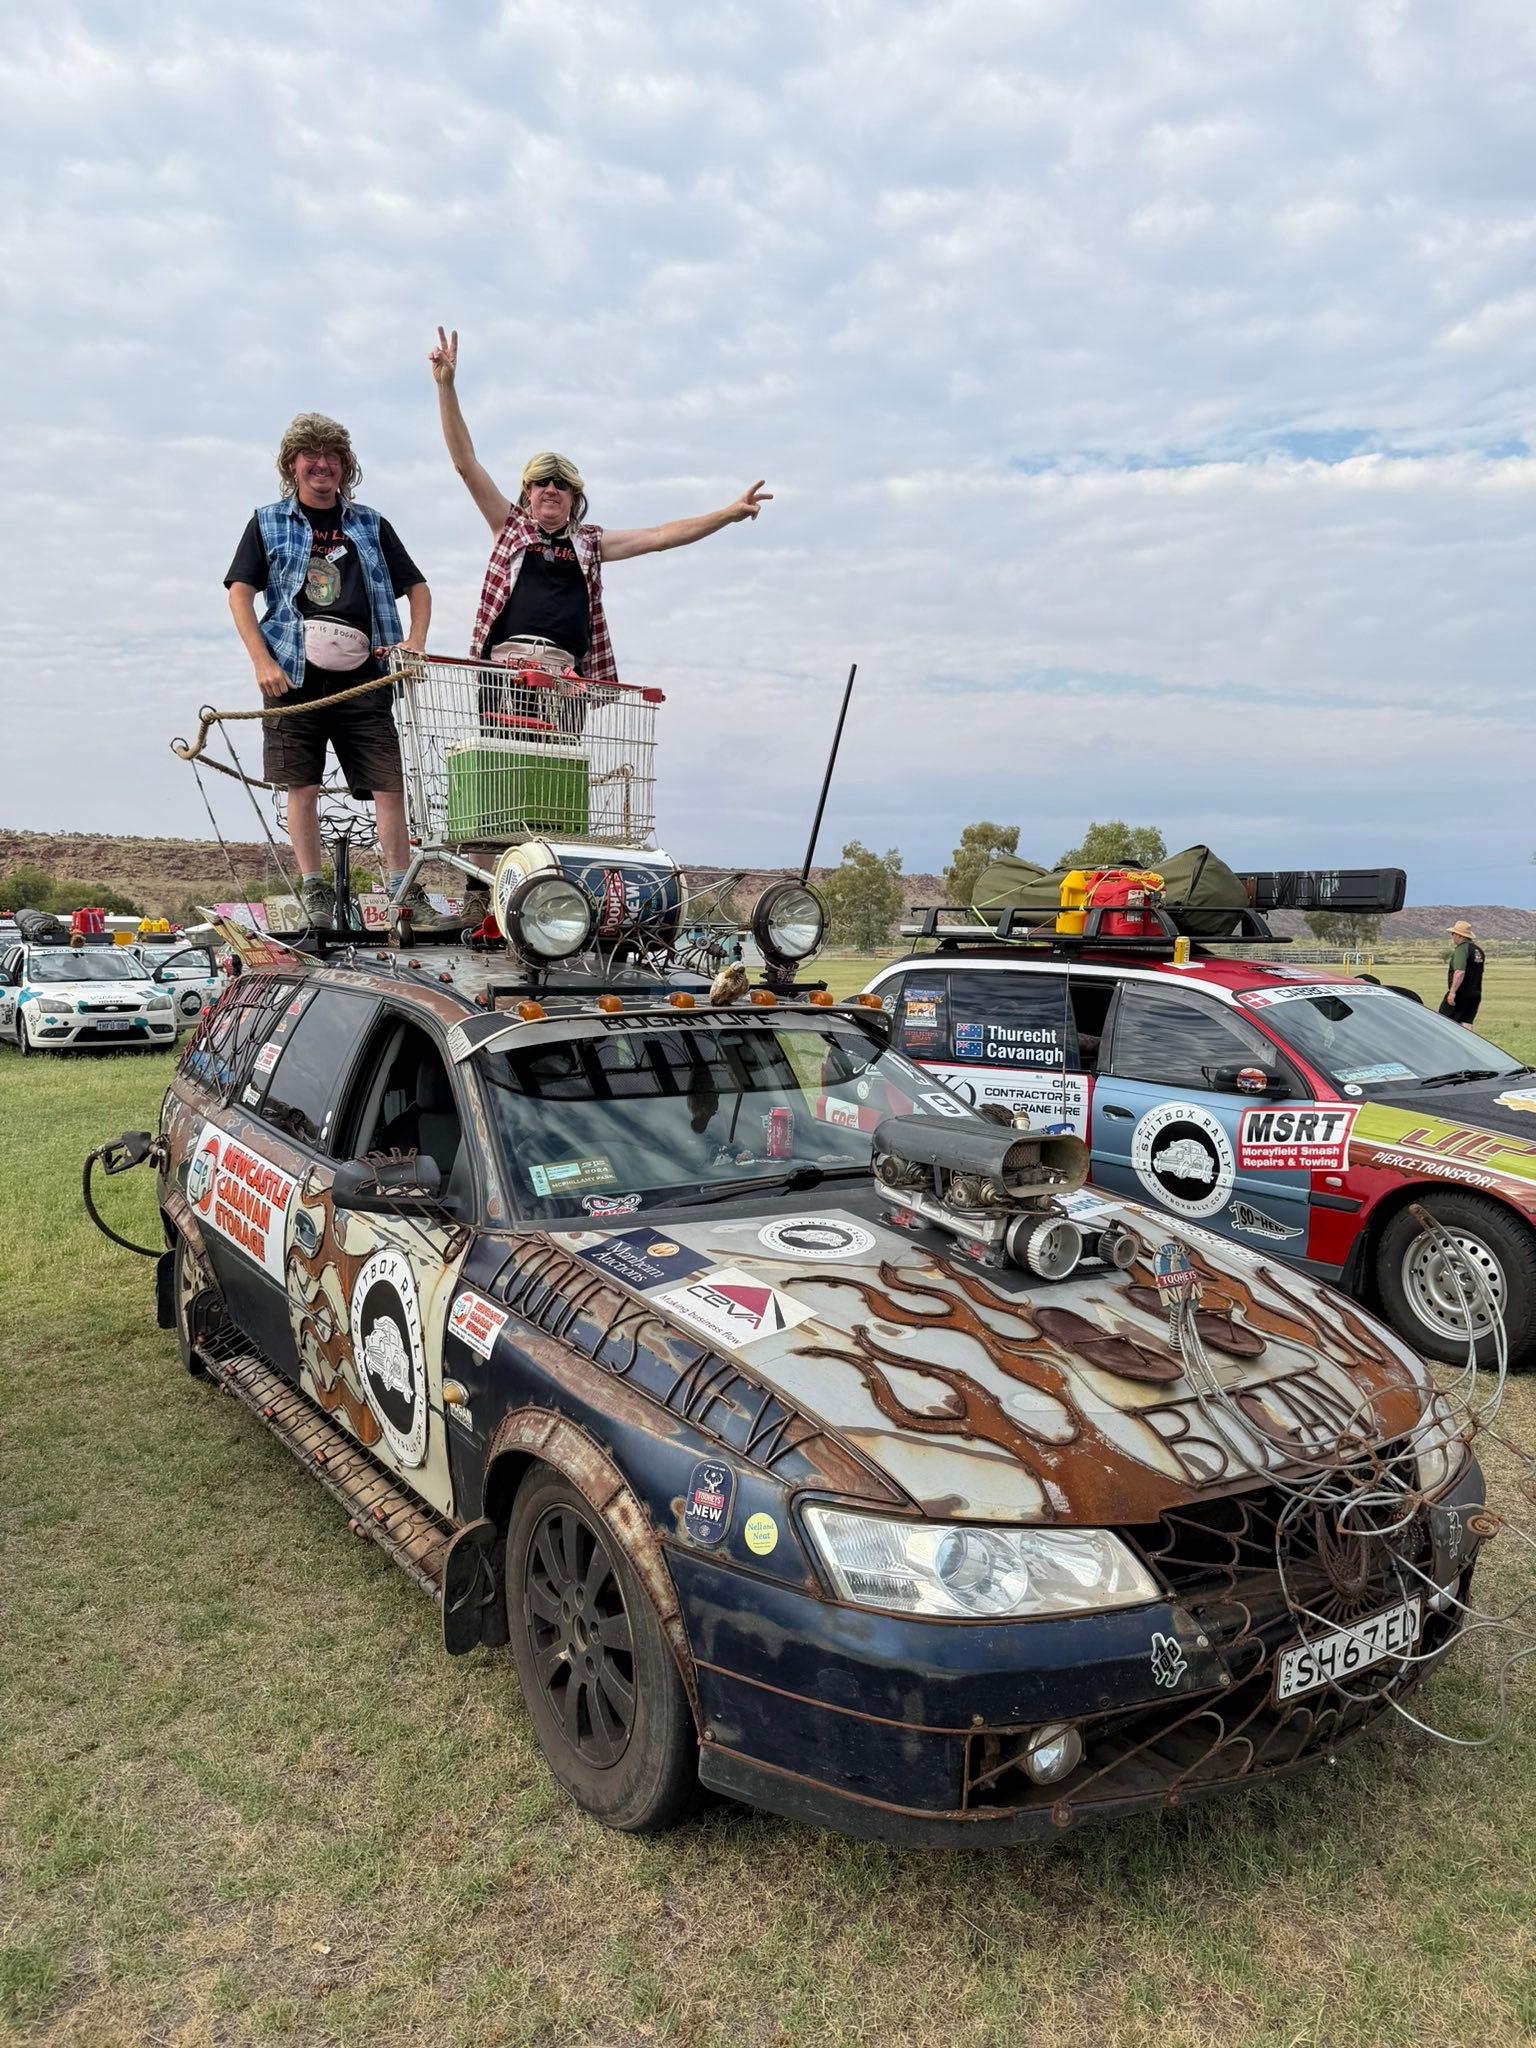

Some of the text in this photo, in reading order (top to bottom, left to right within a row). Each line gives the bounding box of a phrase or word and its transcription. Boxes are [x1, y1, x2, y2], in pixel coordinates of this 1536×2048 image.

[987, 1025, 1057, 1044] Thurecht
[986, 1042, 1064, 1064] Cavanagh
[984, 1087, 1081, 1102] CONTRACTORS &
[1013, 1103, 1081, 1116] CRANE HIRE
[1141, 1109, 1196, 1151] SHITBOX
[1203, 1117, 1232, 1169] RALLY
[1246, 1112, 1345, 1145] MSRT
[1242, 1145, 1340, 1157] Morayfield Smash
[1243, 1157, 1338, 1169] Repairs & Towing
[221, 1142, 293, 1212] NEWCASTLE
[1371, 1151, 1501, 1190] PIERCE TRANSPORT
[217, 1175, 272, 1235] CARAVAN
[215, 1201, 265, 1263] STORAGE
[591, 1249, 648, 1283] Auctions
[605, 1240, 665, 1279] Manheim
[1160, 1270, 1197, 1285] TOOHEYS
[352, 1259, 424, 1378] SHITBOX RALLY
[658, 1293, 743, 1346] Making business flow
[692, 1503, 723, 1522] NEW
[698, 1491, 722, 1504] TOOHEYS
